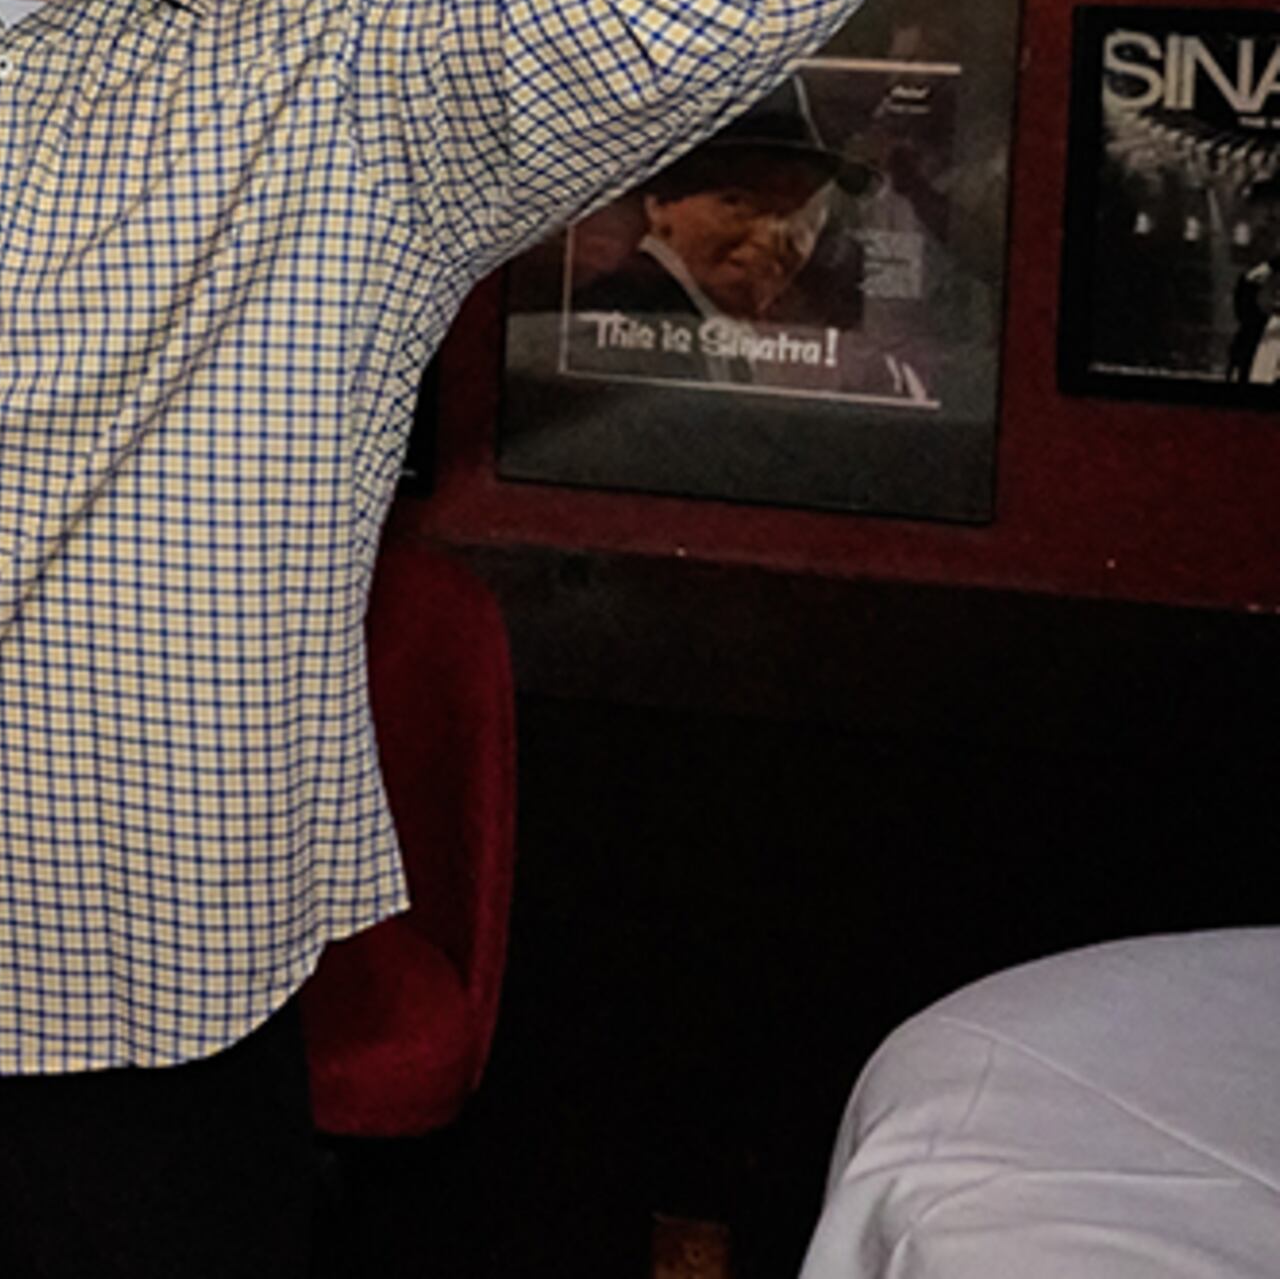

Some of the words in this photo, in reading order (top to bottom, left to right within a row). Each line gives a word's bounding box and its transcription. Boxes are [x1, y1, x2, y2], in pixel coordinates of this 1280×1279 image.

[587, 311, 656, 349] This
[662, 322, 691, 353] is
[697, 317, 839, 368] Sinatra!
